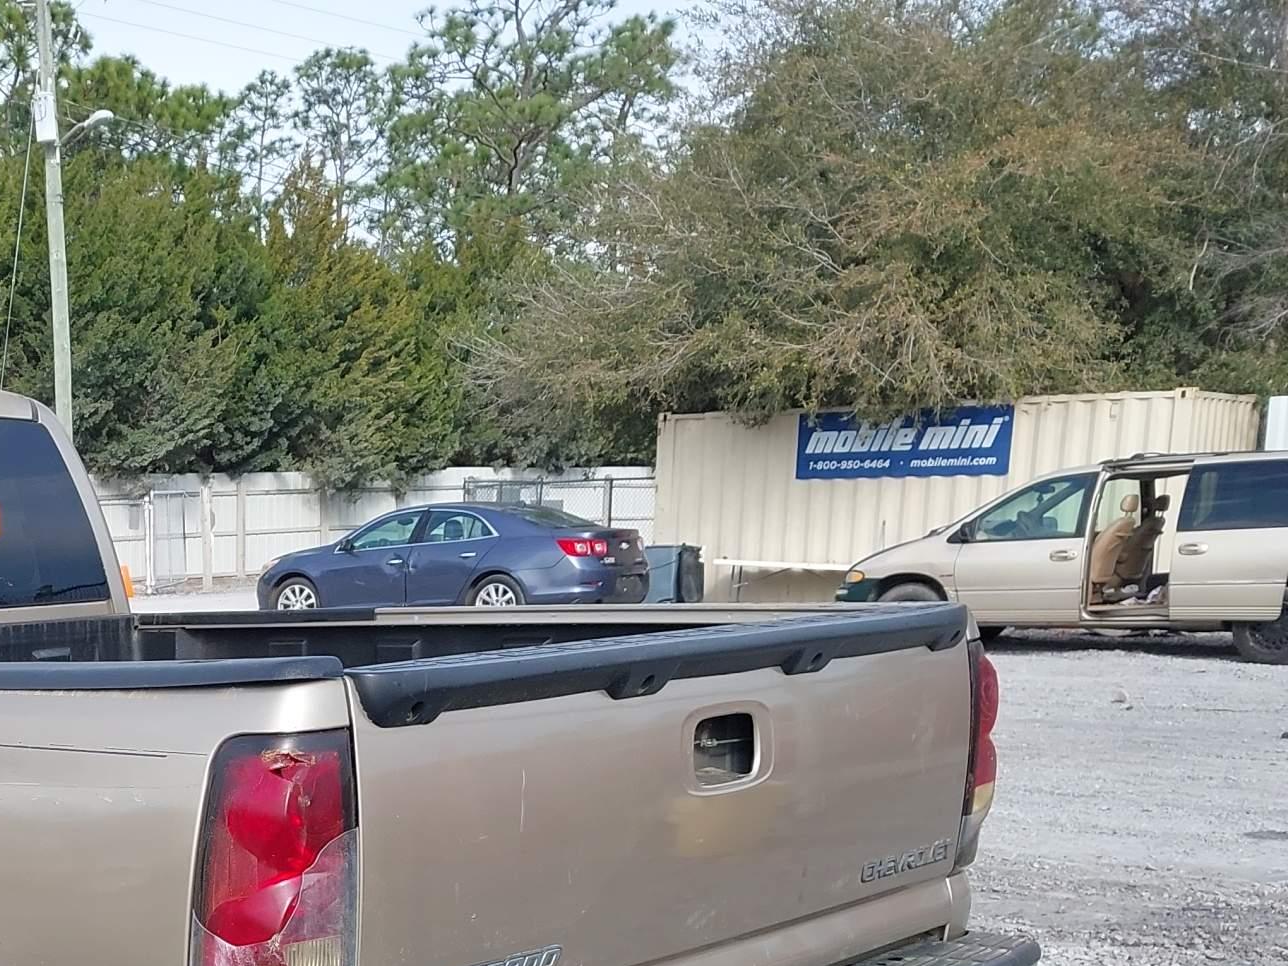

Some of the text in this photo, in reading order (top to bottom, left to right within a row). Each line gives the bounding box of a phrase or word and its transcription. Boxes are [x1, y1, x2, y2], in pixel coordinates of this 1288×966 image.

[805, 417, 1003, 454] mobile mini
[809, 456, 997, 471] 1-800-950-6464 mobilemini.com
[860, 840, 952, 884] CHEVROLET
